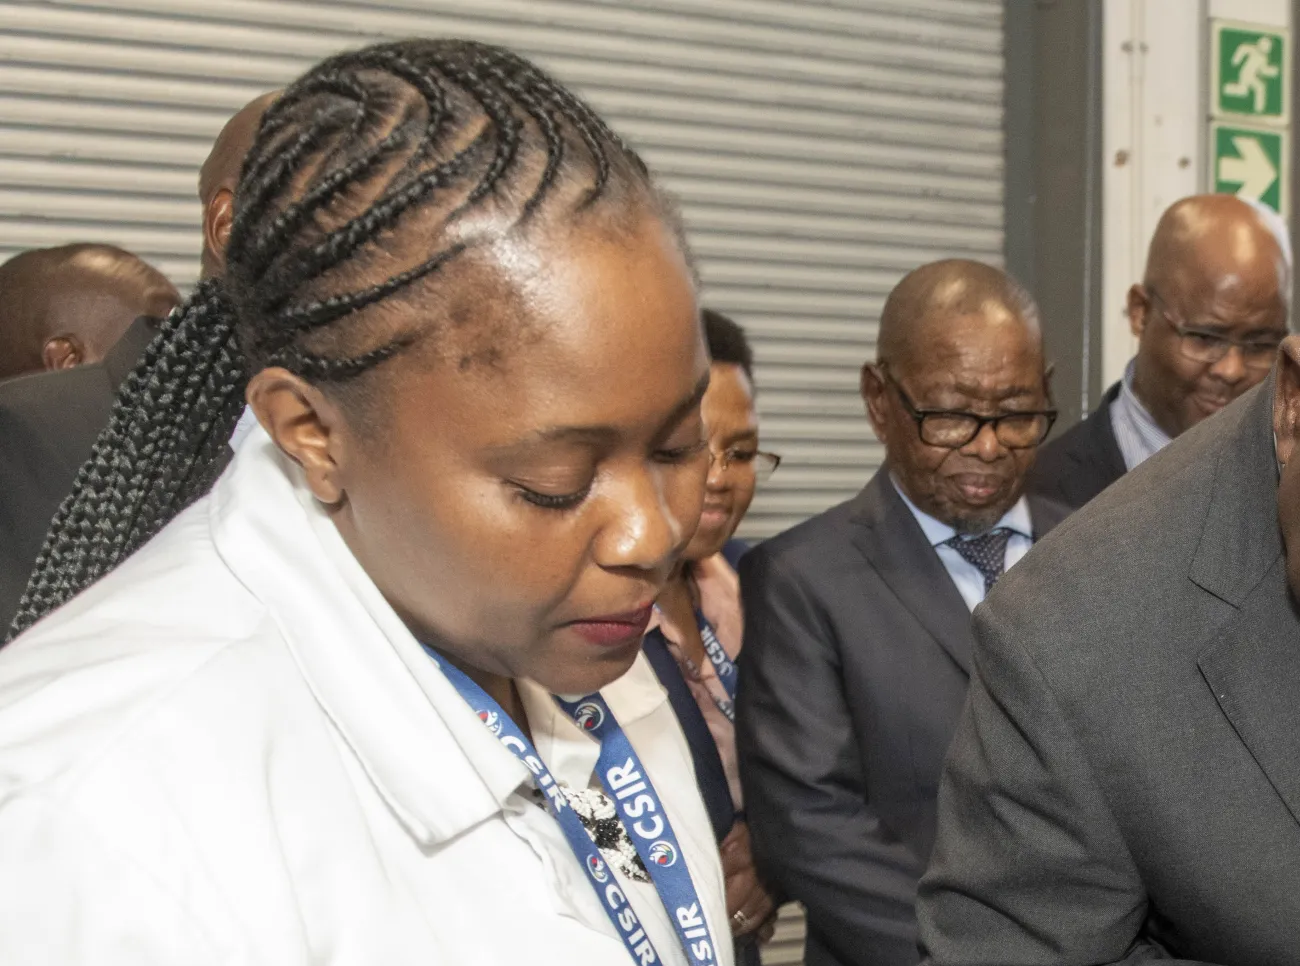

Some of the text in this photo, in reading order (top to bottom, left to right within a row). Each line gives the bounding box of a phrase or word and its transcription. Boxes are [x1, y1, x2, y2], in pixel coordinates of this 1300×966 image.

[701, 625, 725, 664] CSIR
[501, 735, 567, 814] CSIR
[606, 757, 664, 840] CSIR
